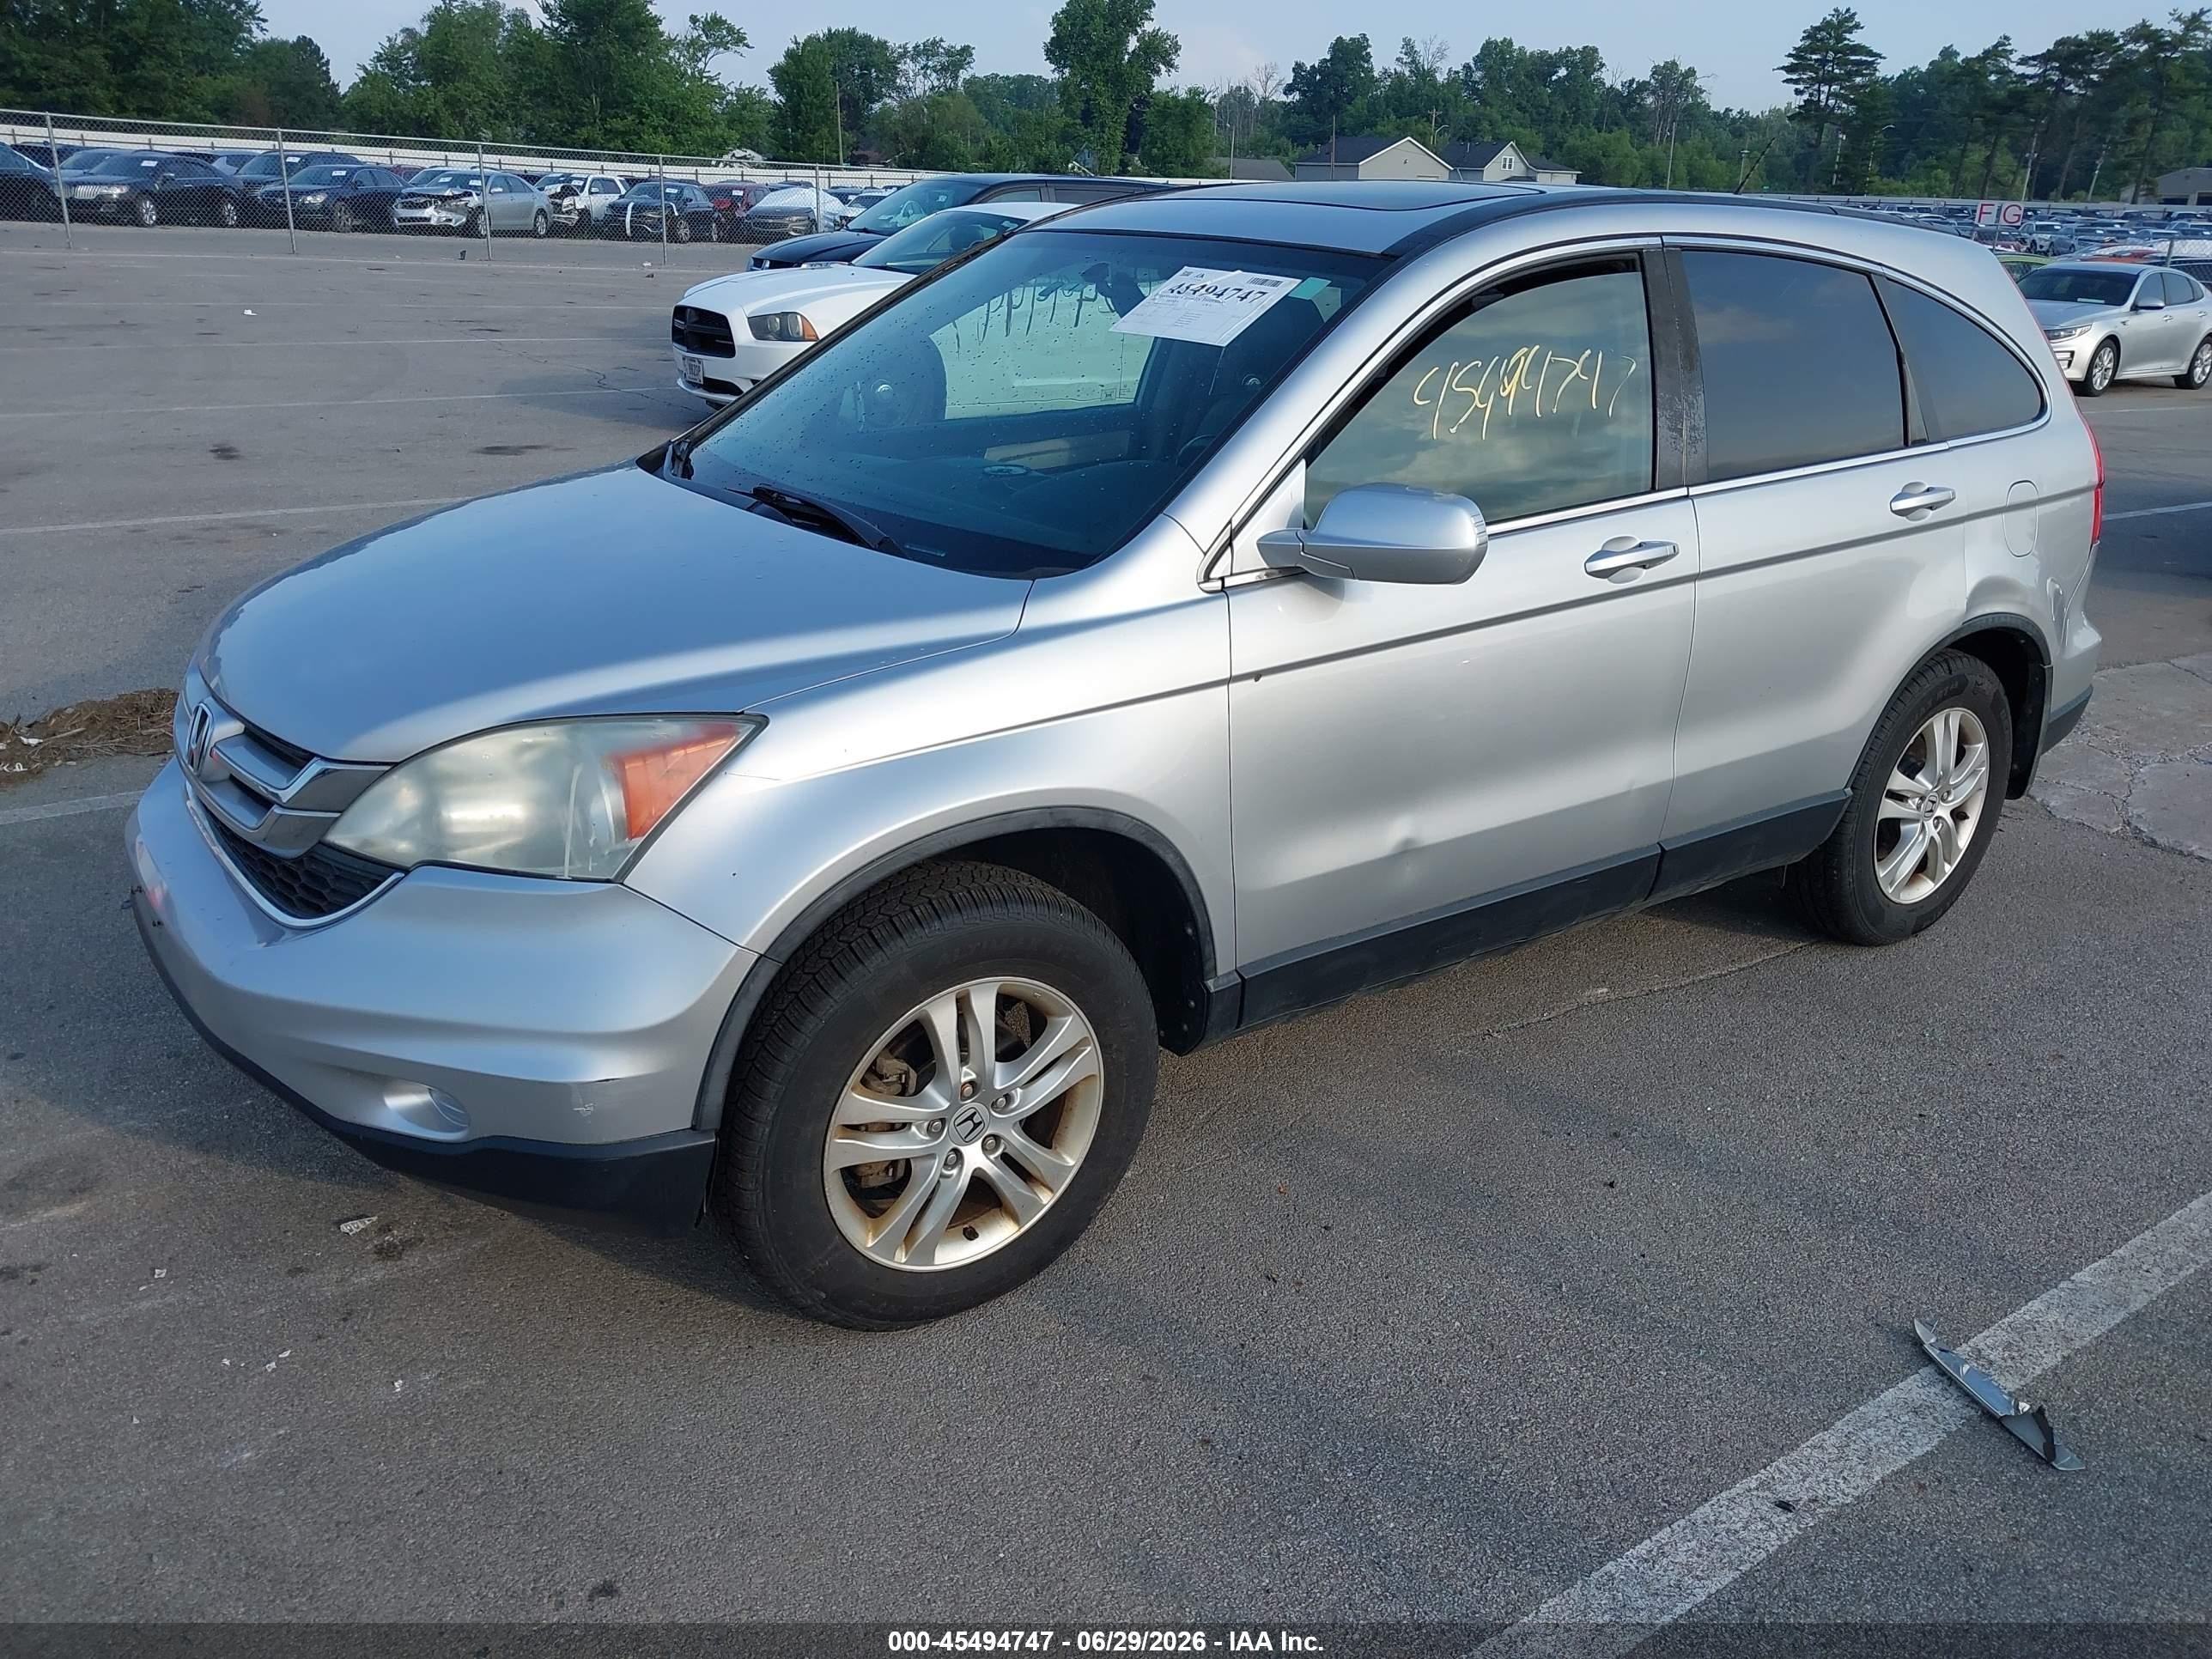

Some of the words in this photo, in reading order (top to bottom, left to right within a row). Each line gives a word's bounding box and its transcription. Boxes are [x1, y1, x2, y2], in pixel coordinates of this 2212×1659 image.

[1978, 204, 1994, 223] F
[2003, 204, 2021, 223] G
[1168, 283, 1269, 304] 45494747
